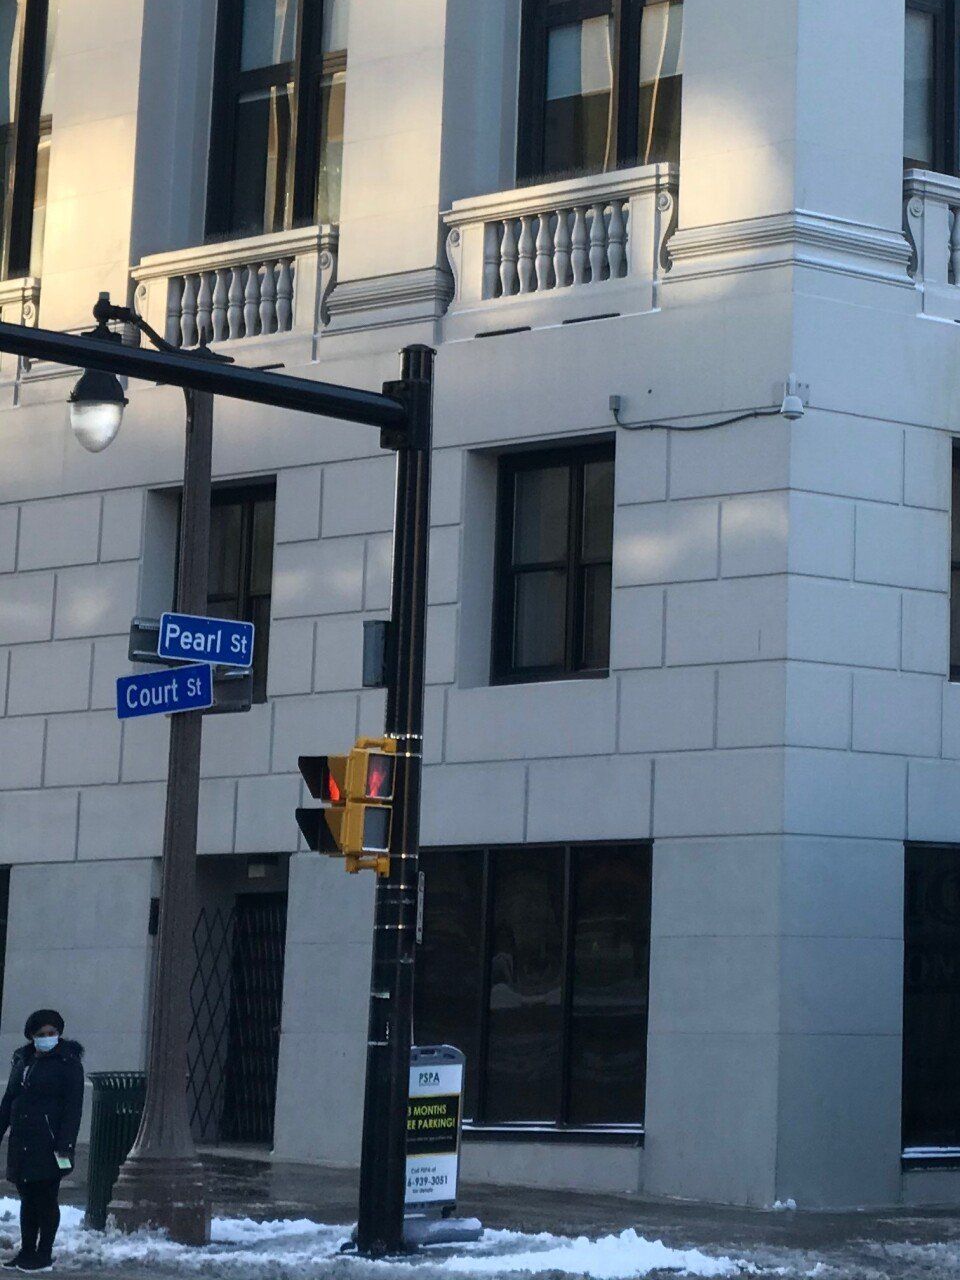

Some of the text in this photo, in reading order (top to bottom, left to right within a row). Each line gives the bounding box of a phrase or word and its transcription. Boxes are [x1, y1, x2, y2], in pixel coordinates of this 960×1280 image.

[165, 623, 248, 654] Pearl St
[126, 678, 202, 709] Court St
[418, 1072, 440, 1083] PSPA
[413, 1104, 447, 1116] MONTHS
[418, 1118, 456, 1129] PARKING!
[407, 1175, 448, 1187] 6-939-3051
